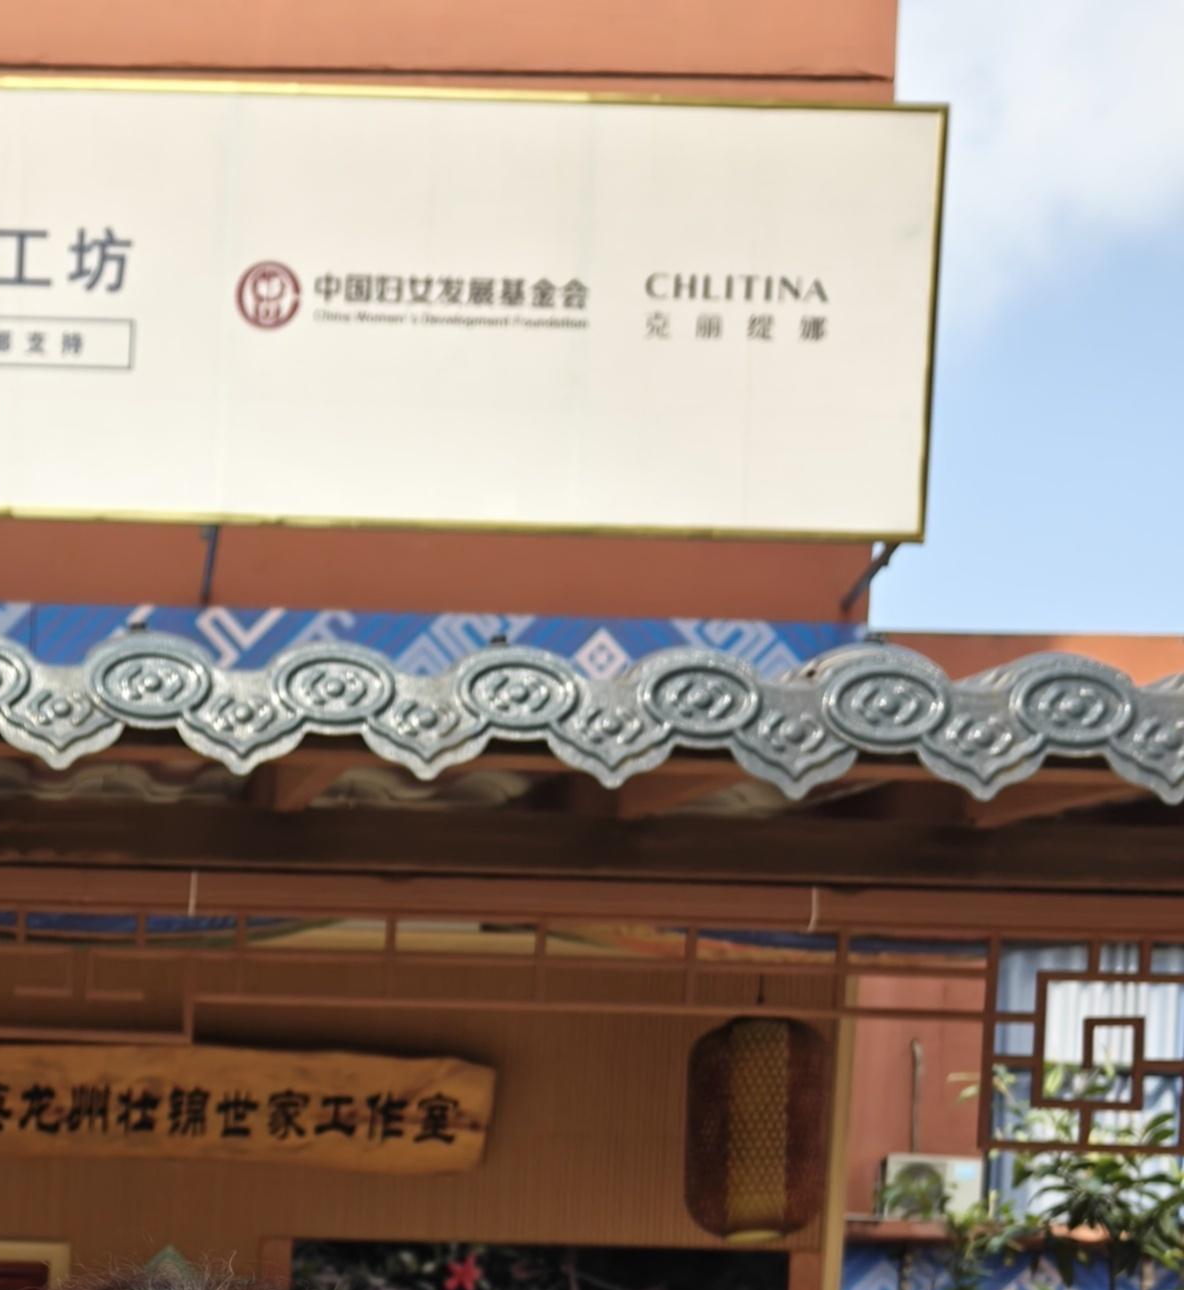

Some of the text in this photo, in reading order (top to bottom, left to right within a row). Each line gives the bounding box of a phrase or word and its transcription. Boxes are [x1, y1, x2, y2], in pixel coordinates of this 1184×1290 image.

[314, 272, 589, 309] 中国妇女发展基金会
[644, 272, 829, 302] CHLITINA
[646, 311, 828, 342] 克丽缇娜
